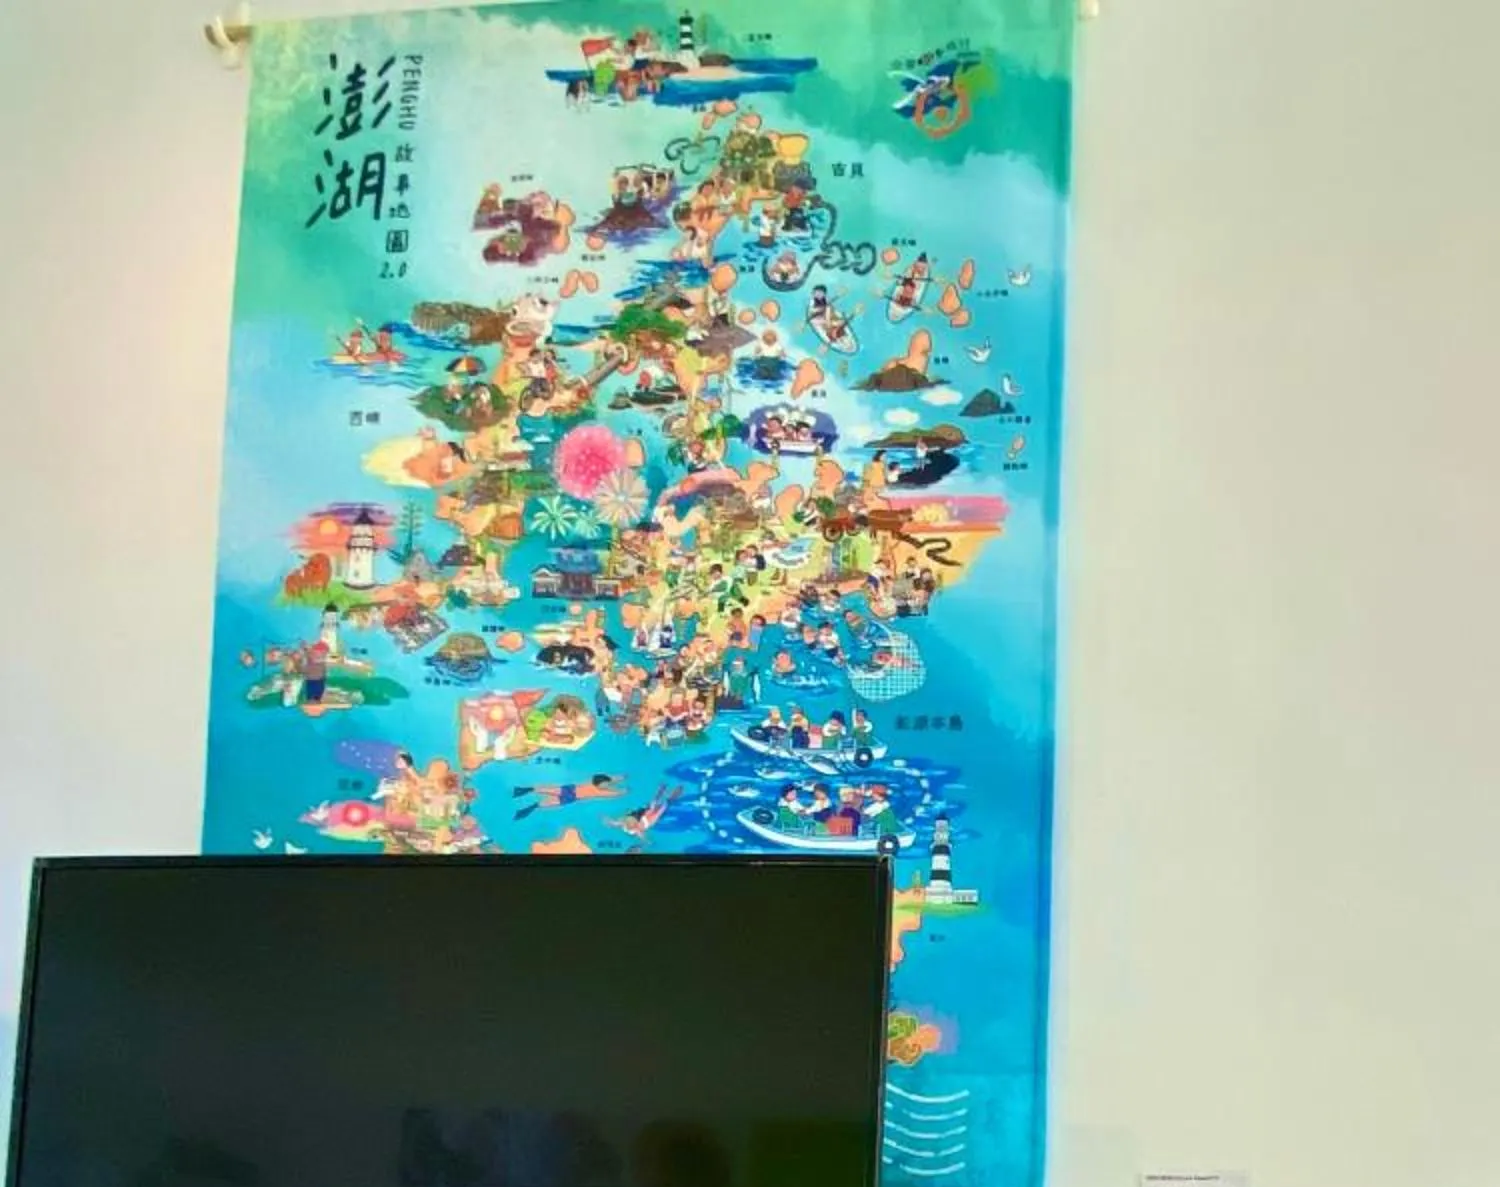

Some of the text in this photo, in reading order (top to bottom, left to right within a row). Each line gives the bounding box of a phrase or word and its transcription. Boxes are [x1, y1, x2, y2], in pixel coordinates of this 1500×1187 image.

[399, 54, 424, 131] PENGHU
[304, 52, 397, 229] 澎湖
[378, 261, 408, 279] 2.0
